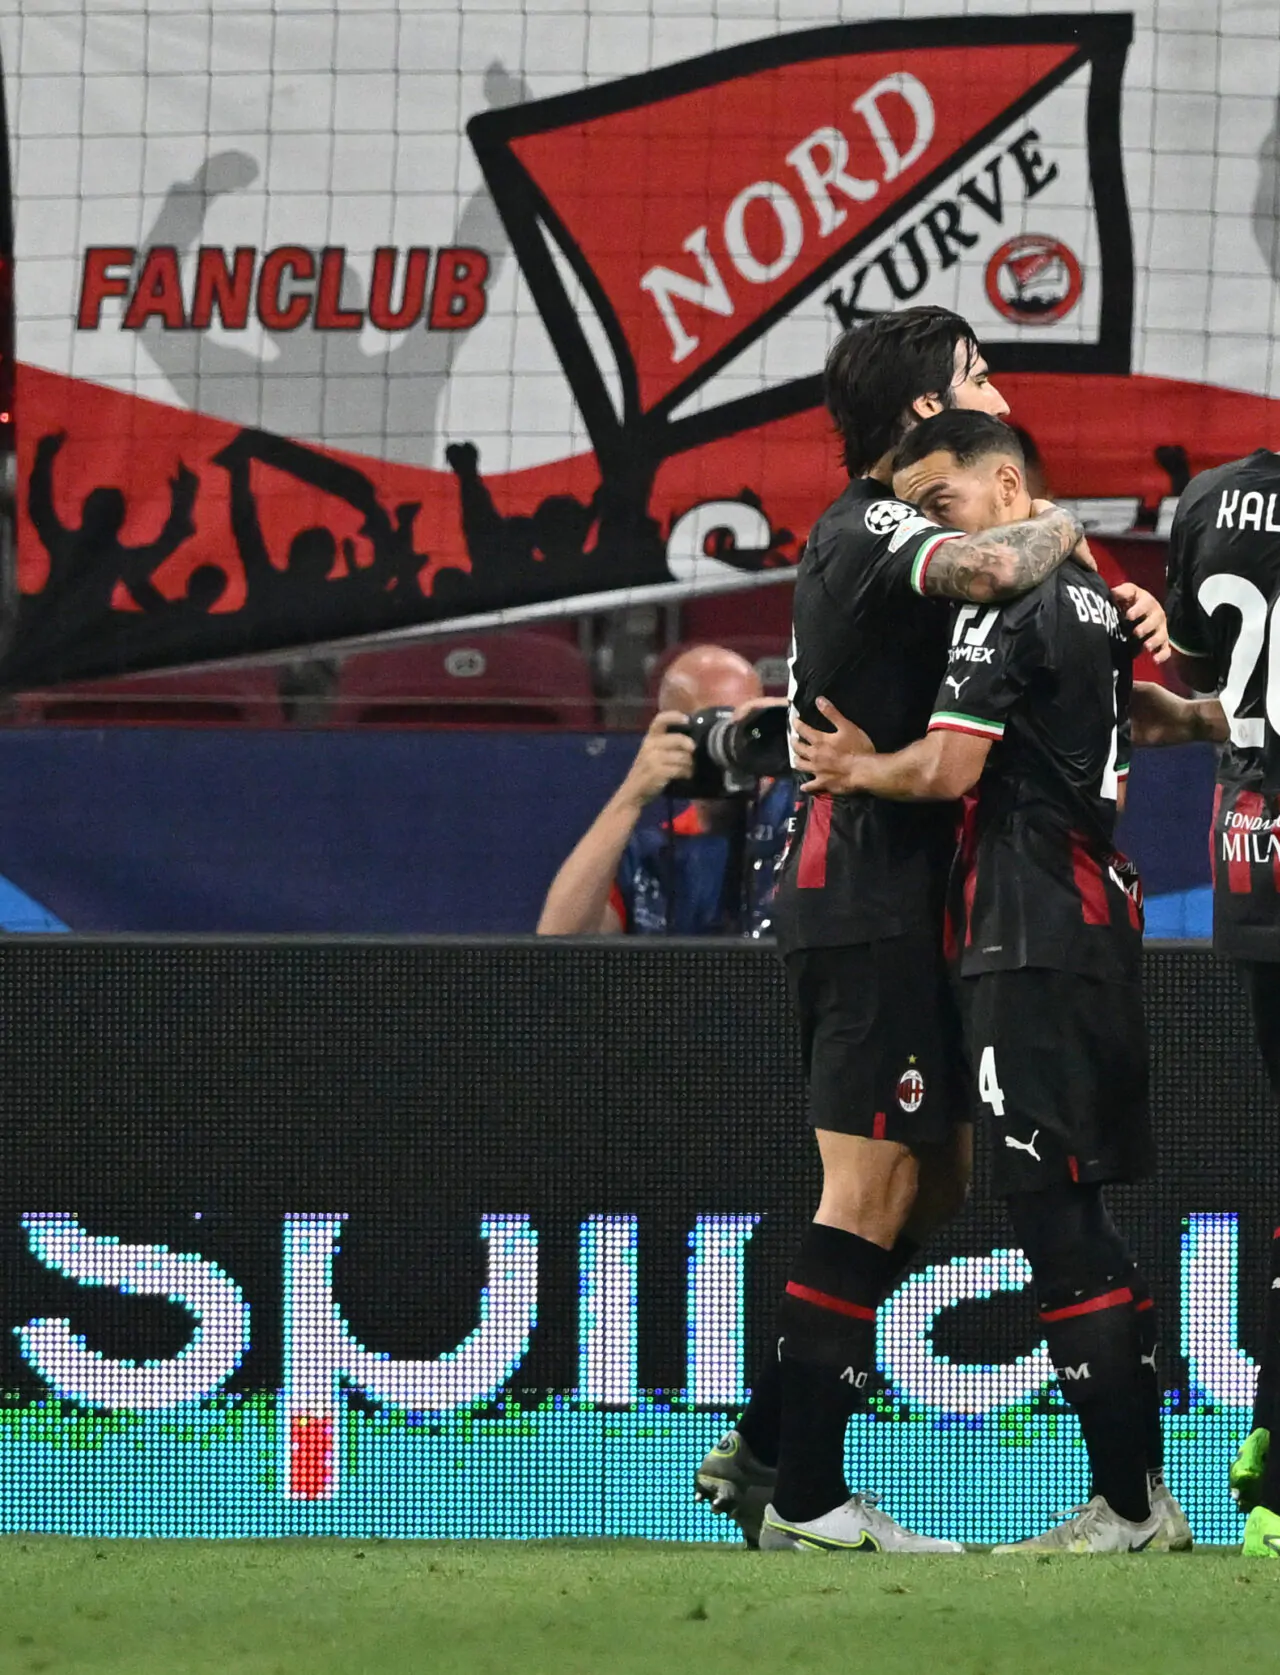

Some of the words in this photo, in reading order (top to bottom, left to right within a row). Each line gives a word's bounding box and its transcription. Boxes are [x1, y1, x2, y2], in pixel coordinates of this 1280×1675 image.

[77, 245, 491, 331] FANCLUB
[640, 71, 935, 363] NORD
[824, 129, 1059, 331] KURVE
[978, 1046, 1005, 1116] 4
